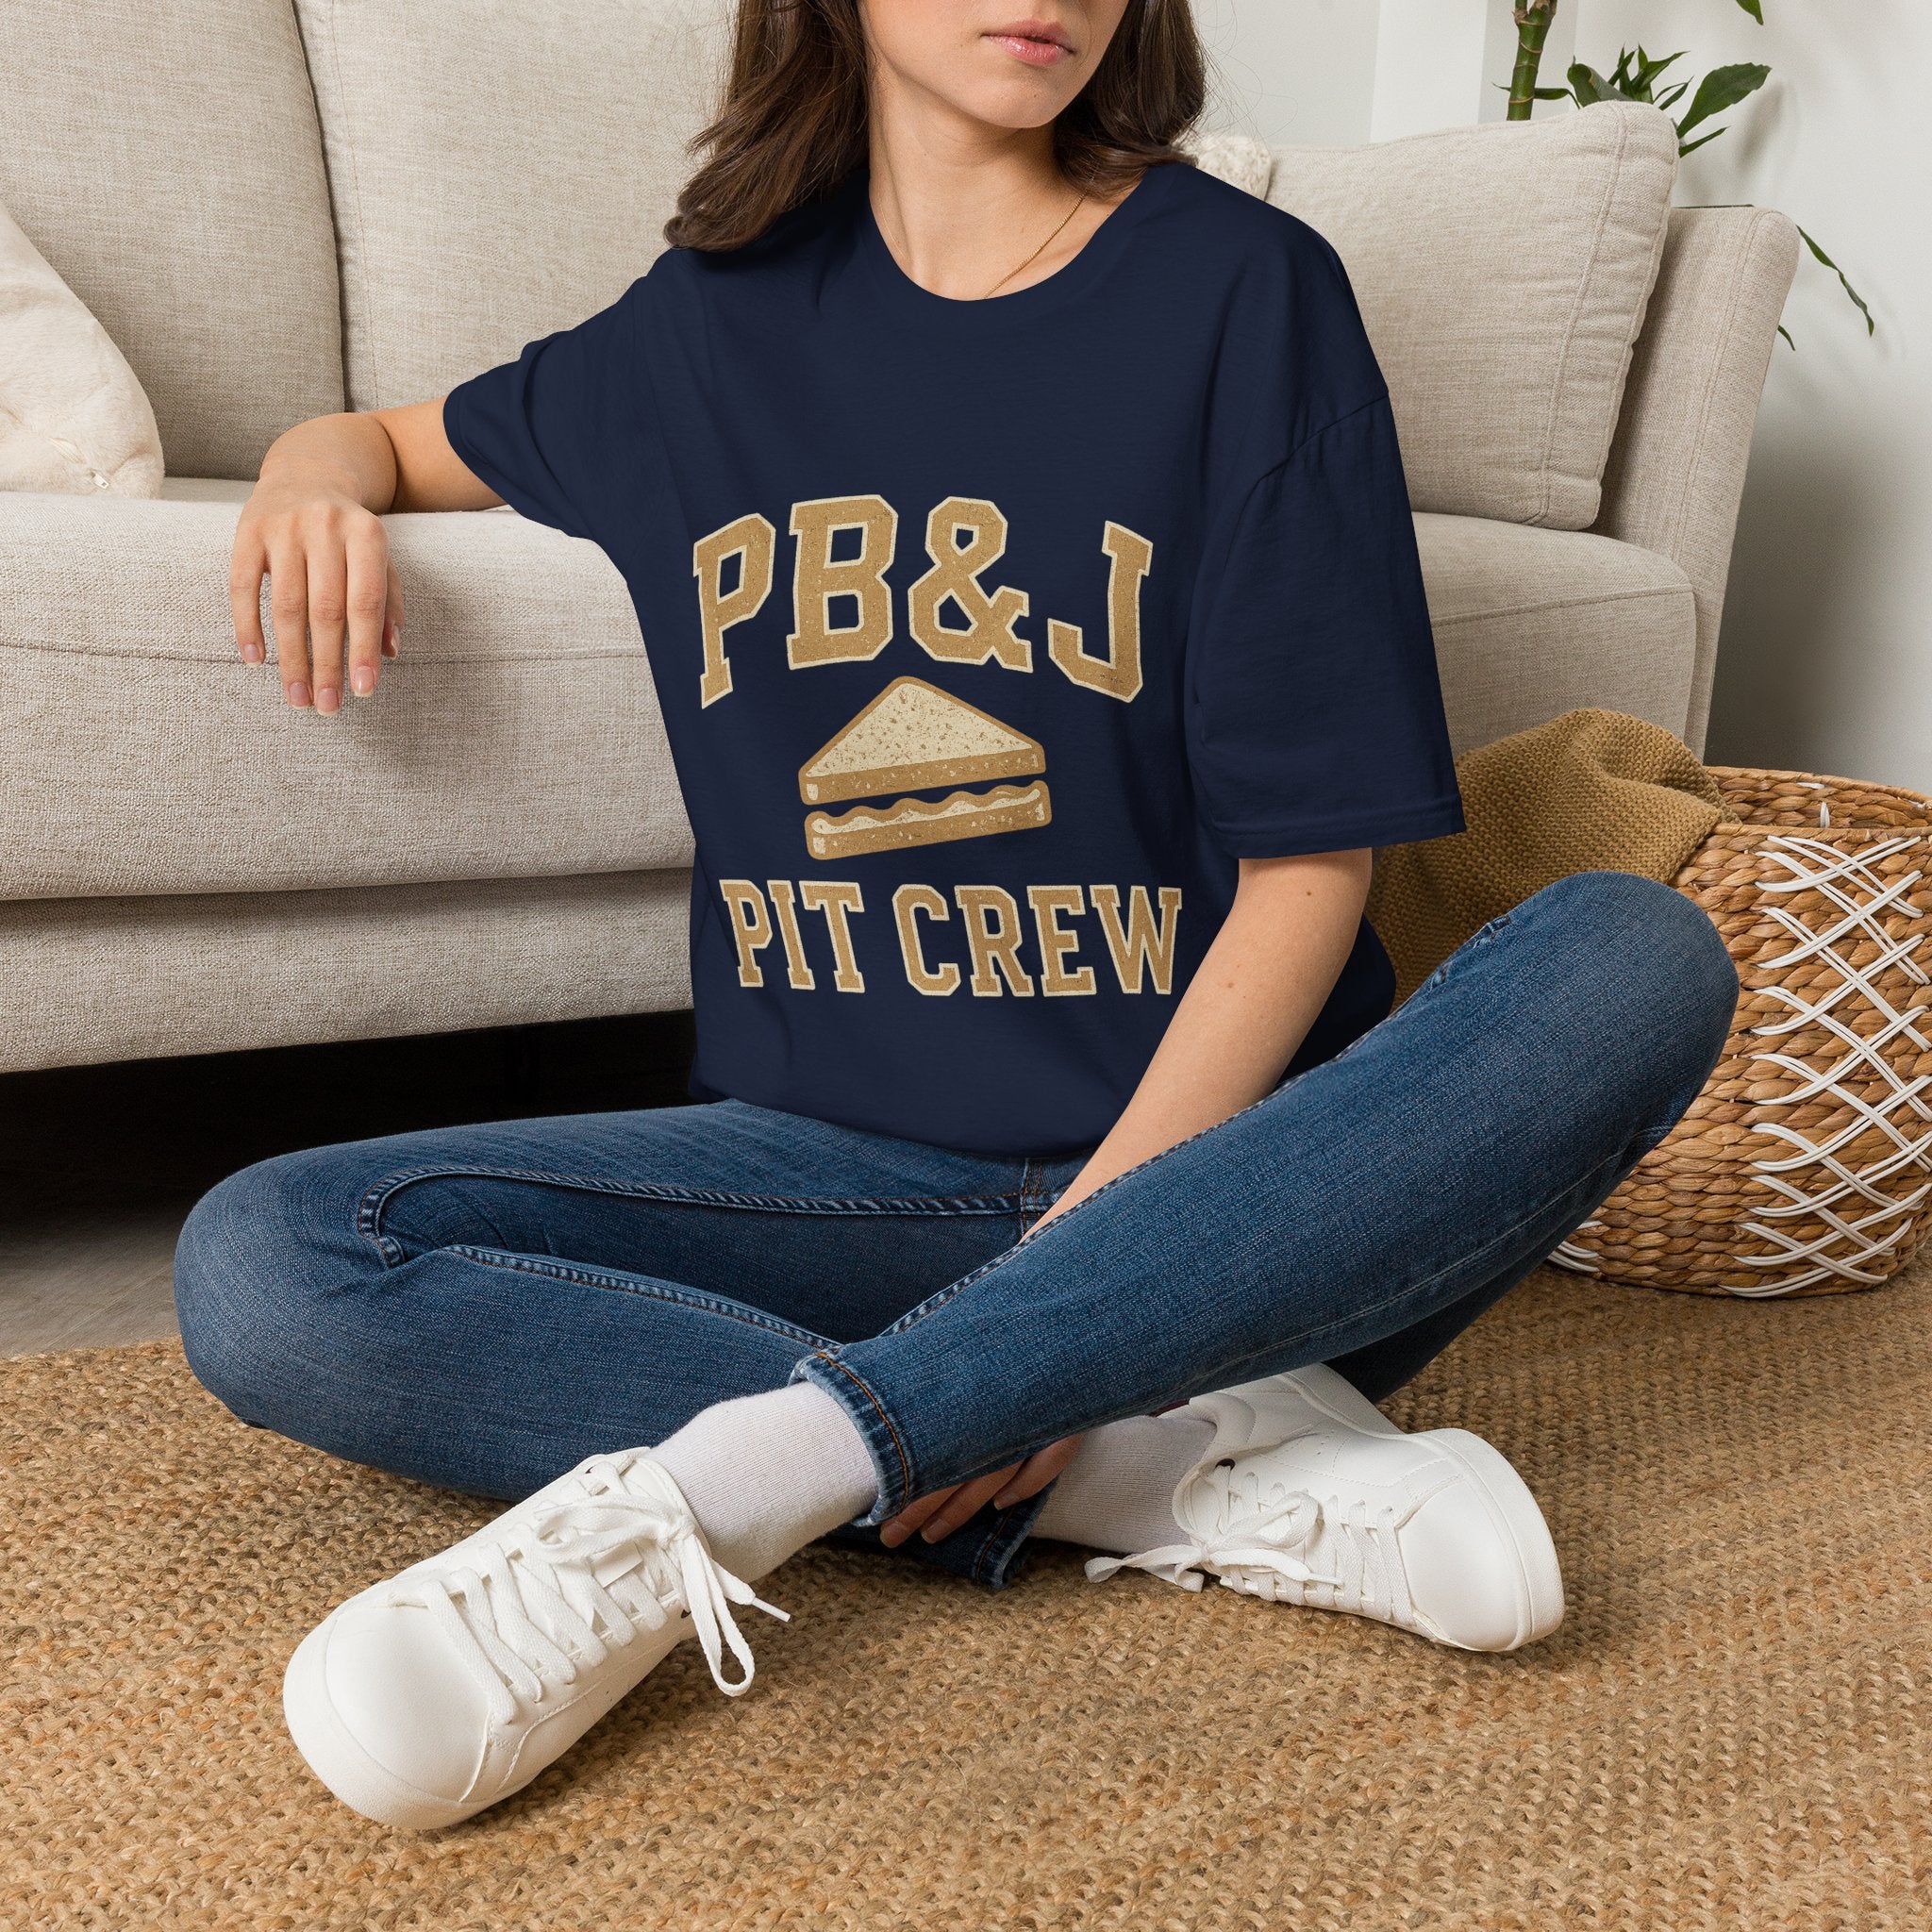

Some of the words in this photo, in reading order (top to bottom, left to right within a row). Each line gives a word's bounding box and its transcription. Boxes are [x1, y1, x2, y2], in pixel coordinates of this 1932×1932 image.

[693, 494, 1154, 709] PB&J
[719, 879, 865, 993] PIT
[892, 884, 1182, 997] CREW
